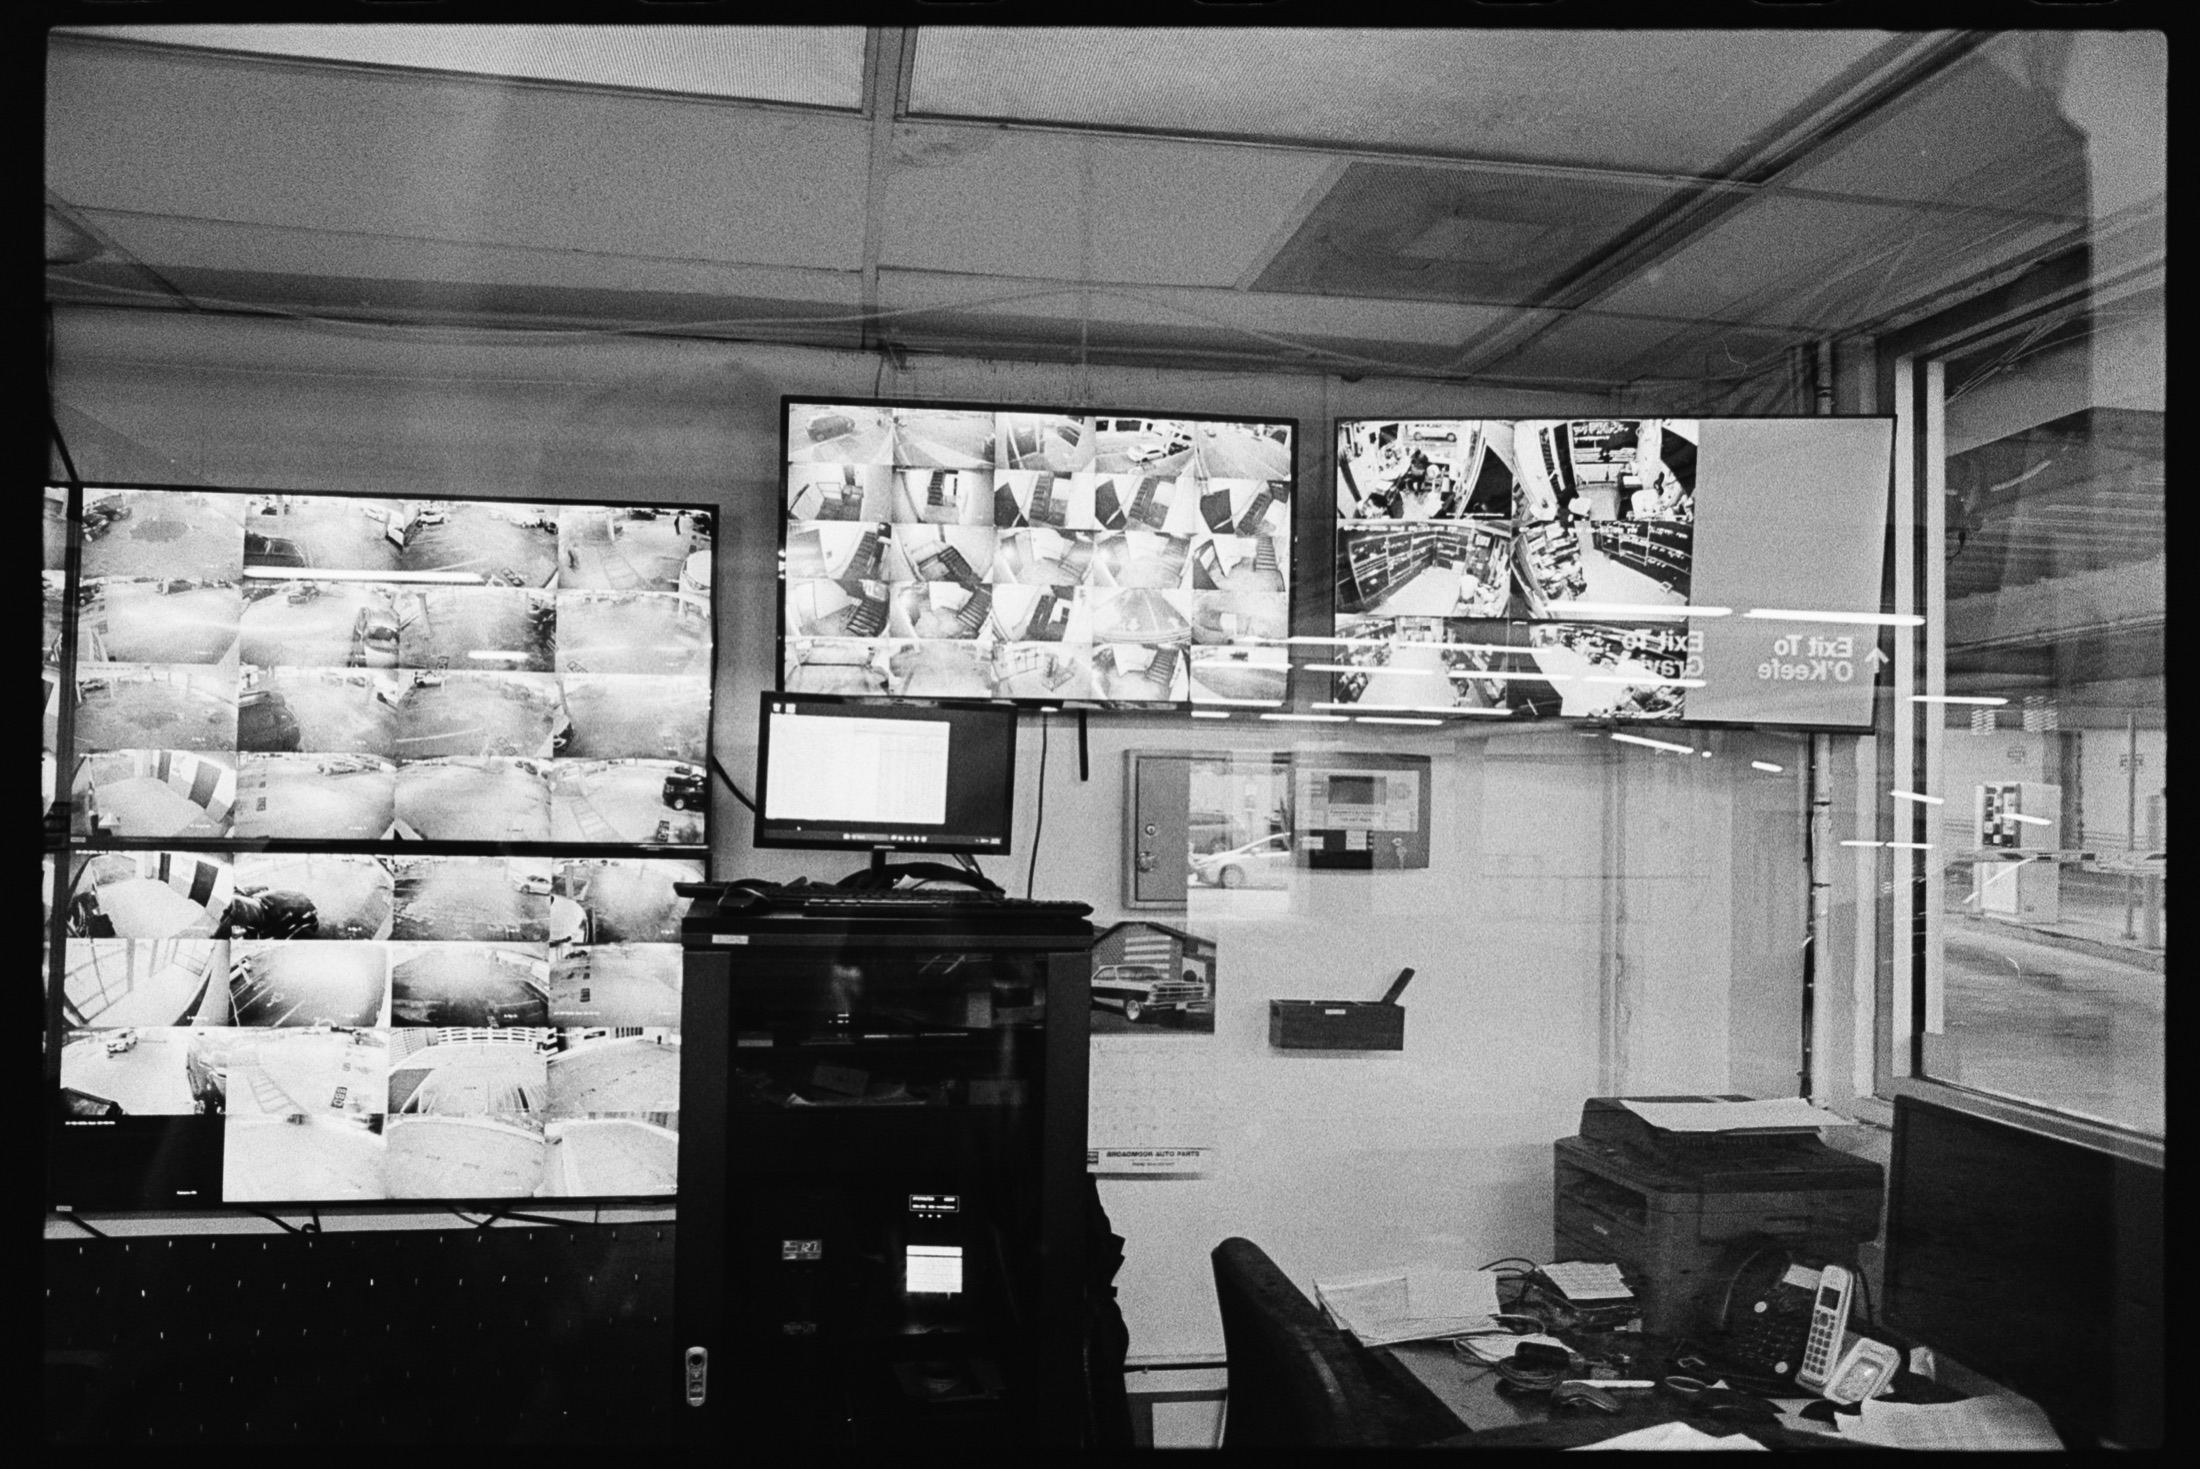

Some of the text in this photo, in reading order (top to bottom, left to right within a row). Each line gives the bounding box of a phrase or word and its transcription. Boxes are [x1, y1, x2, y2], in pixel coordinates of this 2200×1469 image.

[1106, 1150, 1200, 1158] BROADMOOR AUTO PARTS
